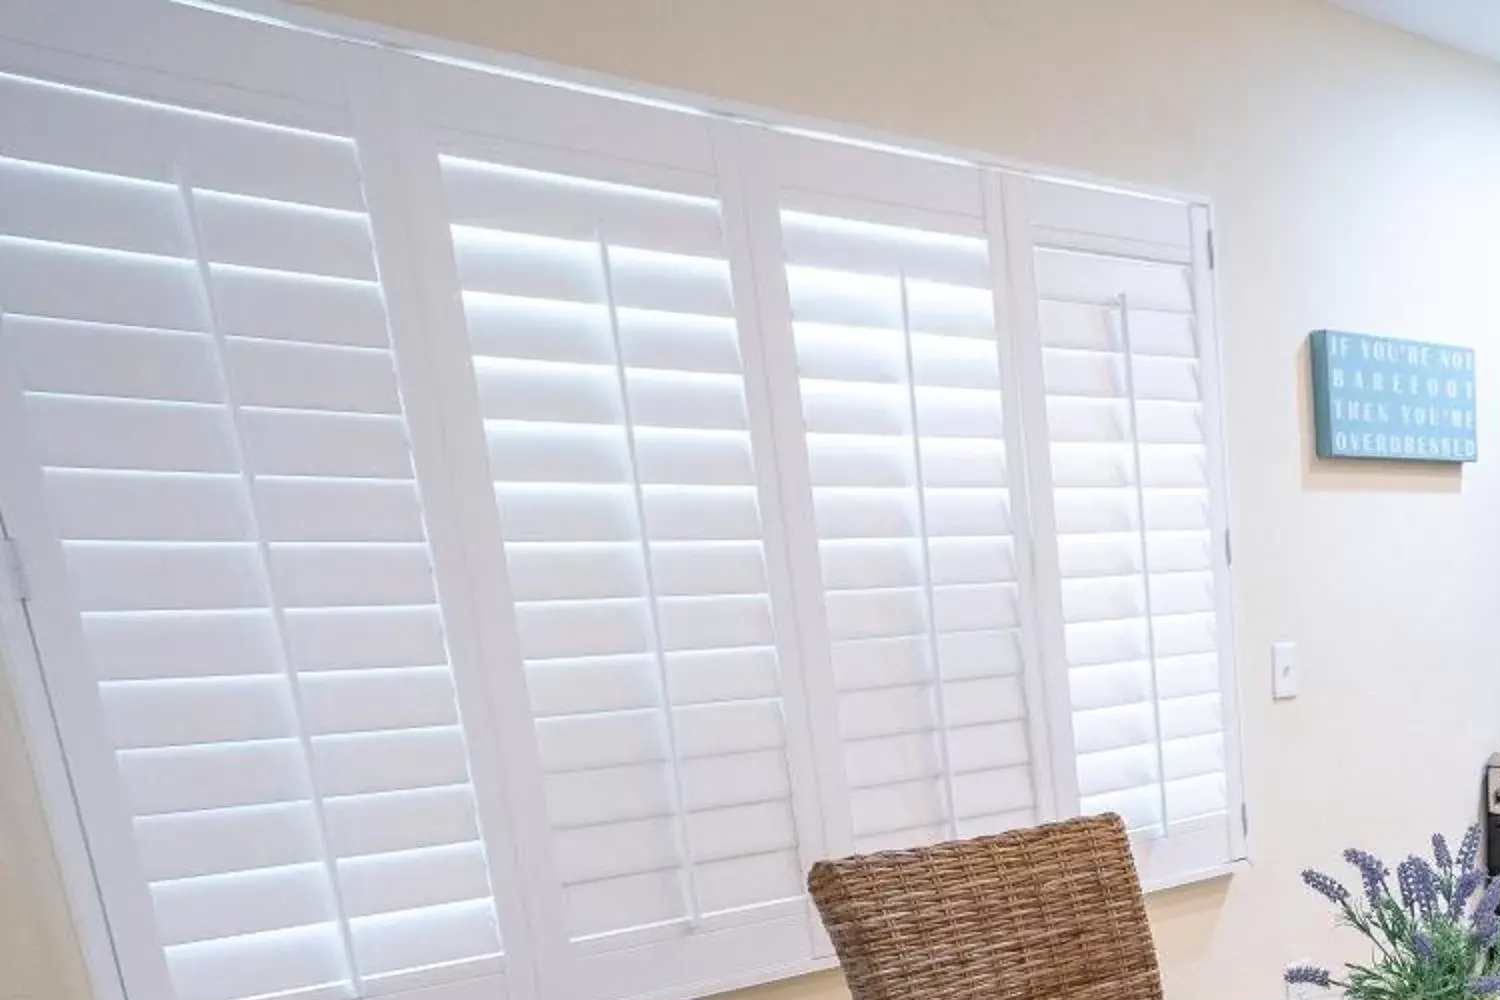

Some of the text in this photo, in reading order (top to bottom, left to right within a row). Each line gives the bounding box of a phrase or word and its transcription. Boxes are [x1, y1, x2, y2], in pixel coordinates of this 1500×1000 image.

[1331, 335, 1353, 360] IF
[1360, 339, 1431, 367] YOU'RE
[1332, 399, 1390, 424] THEN
